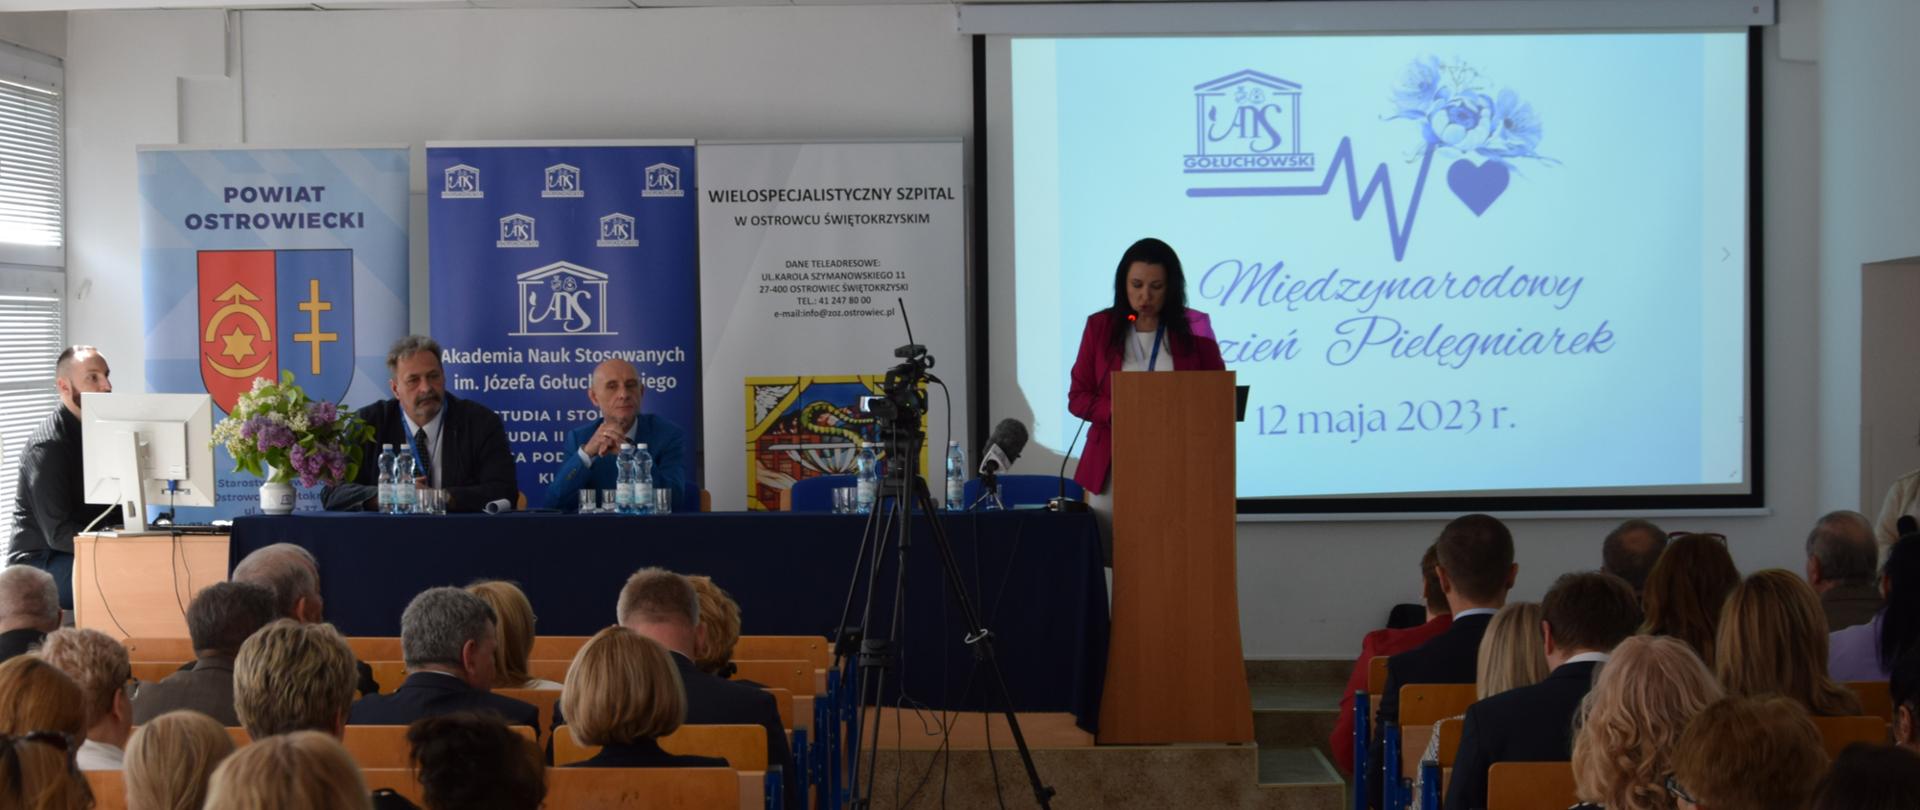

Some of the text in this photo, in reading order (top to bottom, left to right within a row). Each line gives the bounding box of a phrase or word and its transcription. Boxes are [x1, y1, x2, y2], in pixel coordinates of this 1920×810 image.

[1184, 154, 1315, 169] GOŁUCHOWSKI
[223, 186, 326, 204] POWIAT
[708, 187, 955, 203] WIELOSPECJALISTYCZNY SZPITAL
[184, 211, 365, 231] OSTROWIECKI
[734, 211, 931, 227] W OSTROWCU ŚWIĘTOKRZYSKIM
[785, 259, 881, 269] DANE TELEADRESOWE:
[761, 271, 906, 281] UL.KAROLA SZYMANOWSKIEGO 11
[759, 282, 909, 294] 27-400 OSTROWIEC ŚWIĘTOKRZYSKI
[1199, 259, 1584, 313] Międzynarodowy
[818, 296, 830, 305] 41
[831, 296, 847, 304] 247
[860, 296, 872, 304] 00
[1217, 329, 1302, 364] zień
[1326, 315, 1616, 370] Pielęgniarek
[441, 346, 685, 367] Akademia Nauk Stosowanych
[454, 375, 479, 390] im.
[482, 374, 536, 392] Józefa
[494, 410, 551, 422] TUDIA
[1257, 399, 1516, 444] 12 maja 2023 r.
